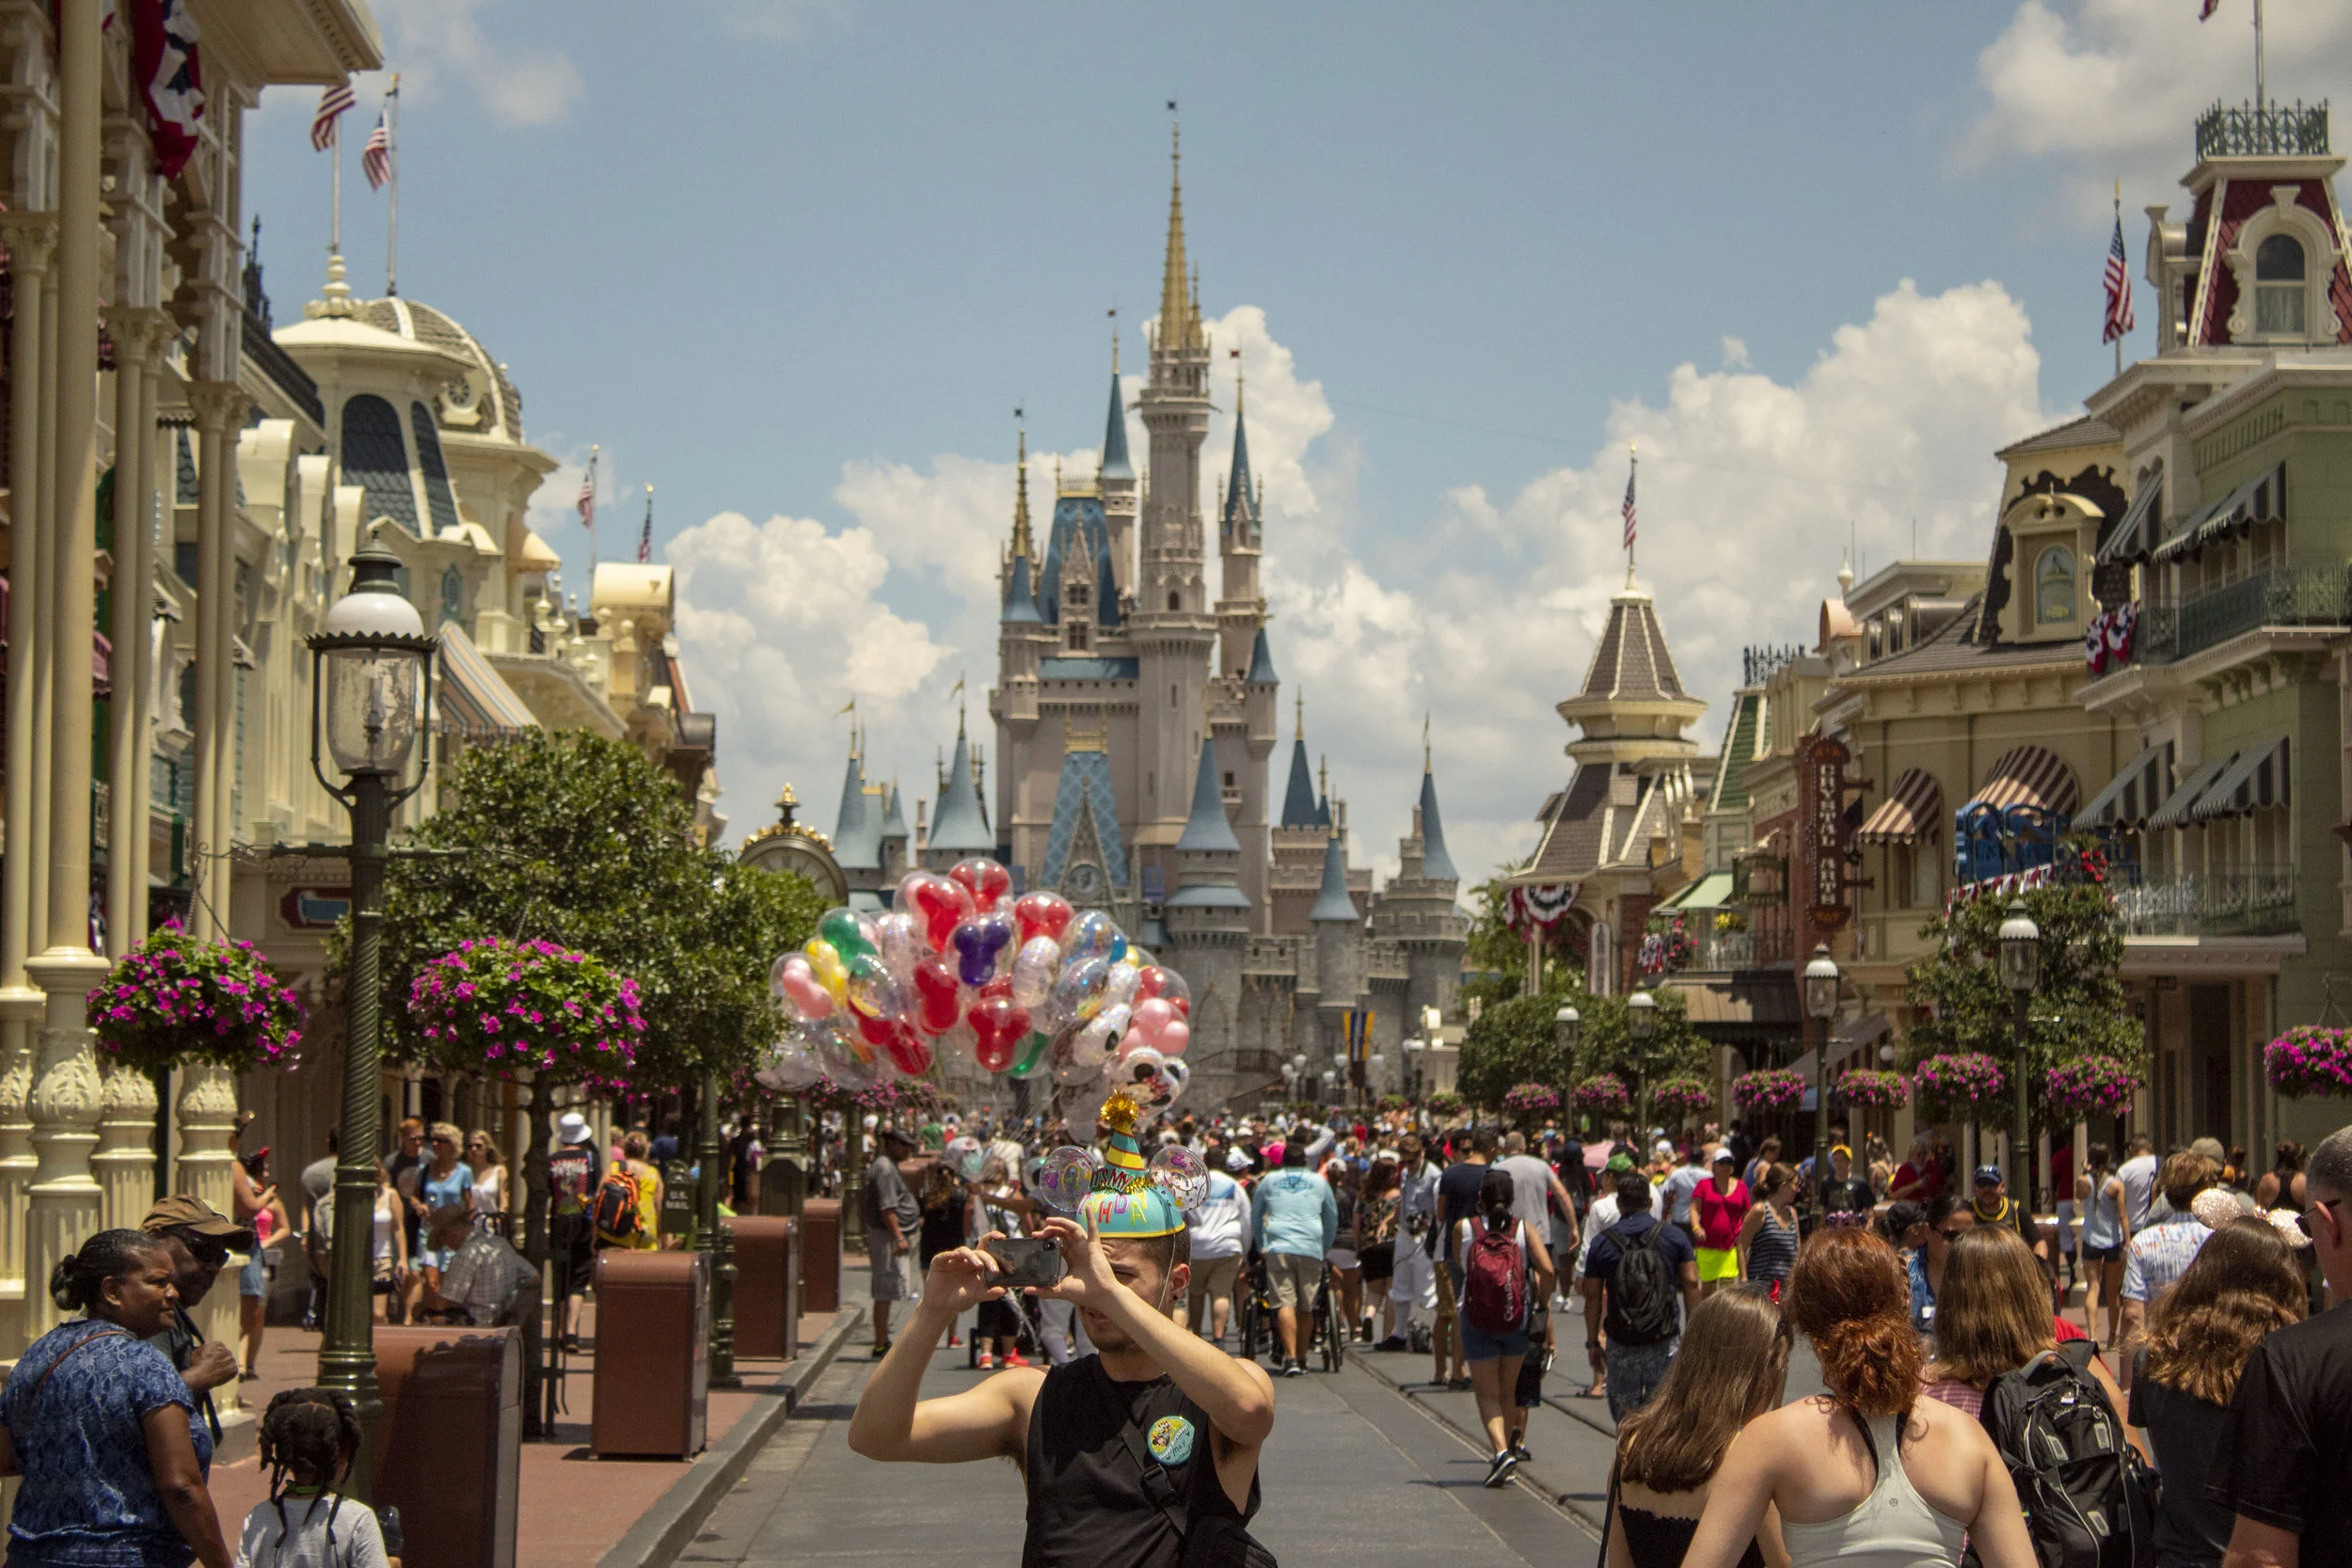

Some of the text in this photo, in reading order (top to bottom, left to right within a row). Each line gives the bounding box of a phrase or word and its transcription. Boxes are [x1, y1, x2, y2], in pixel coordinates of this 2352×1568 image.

[1820, 764, 1836, 905] CRYSTAL ARTS
[1107, 1167, 1134, 1192] MY
